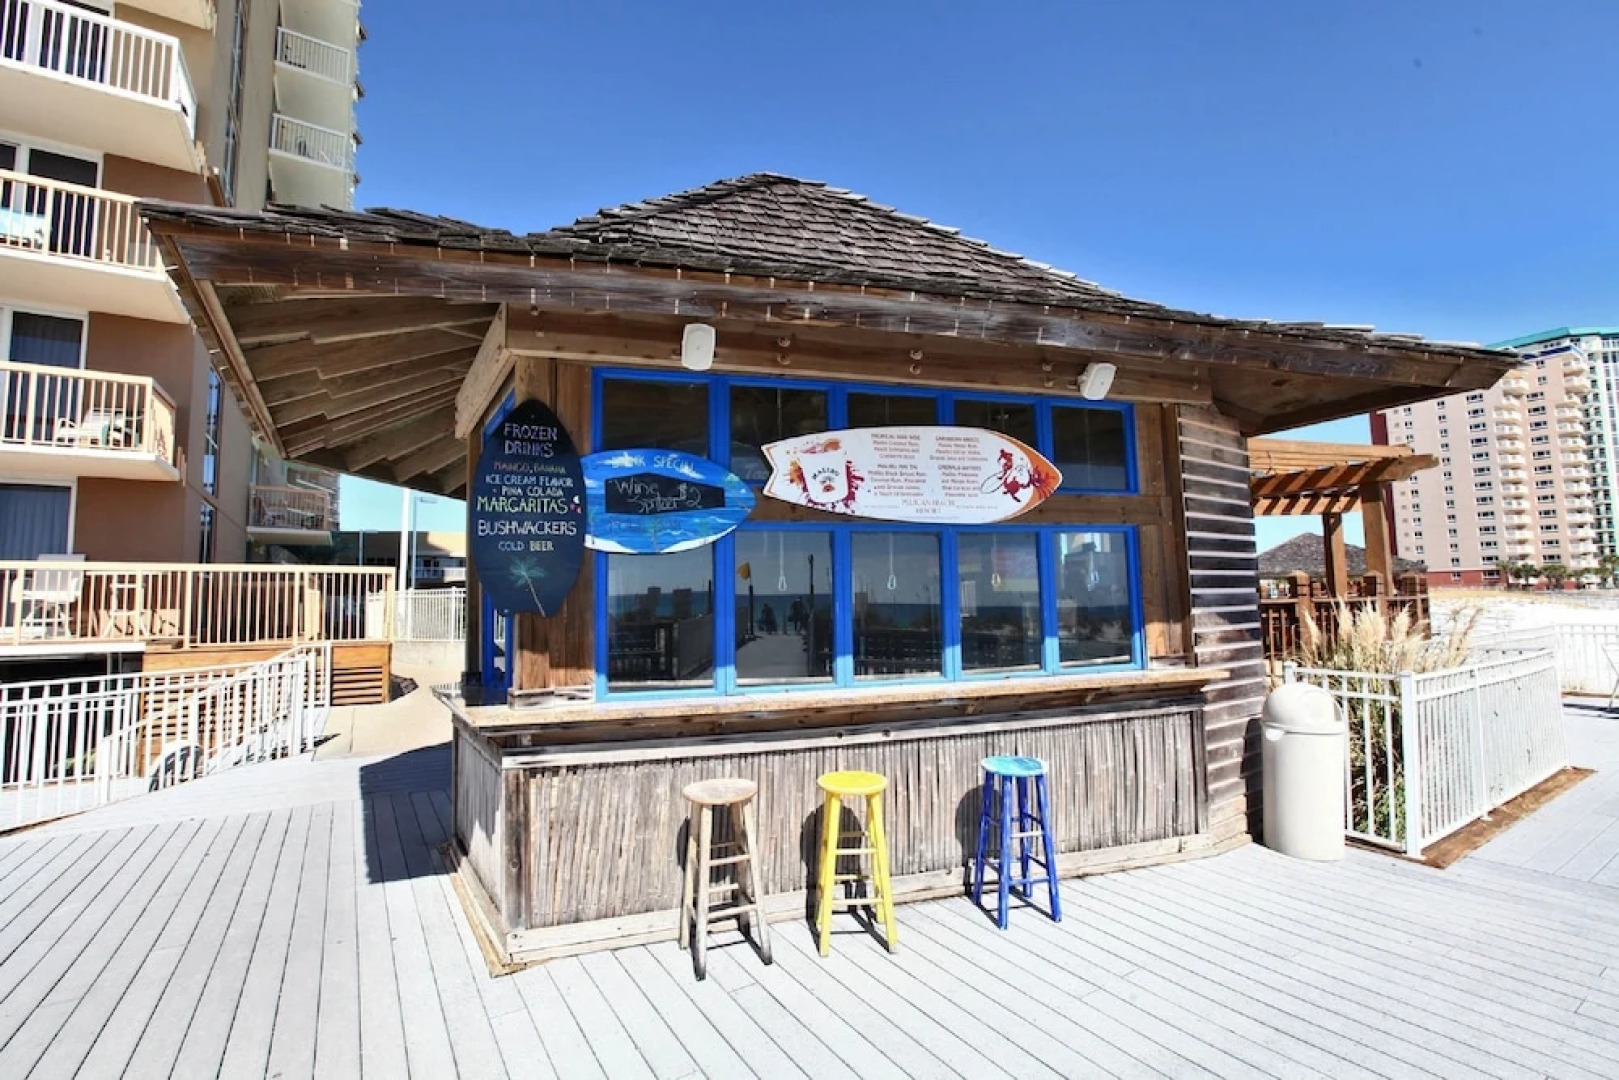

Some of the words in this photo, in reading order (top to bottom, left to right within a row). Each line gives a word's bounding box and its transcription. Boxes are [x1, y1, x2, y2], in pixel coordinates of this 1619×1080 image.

[504, 422, 558, 441] FROZEN
[504, 440, 554, 459] DRINKS
[485, 474, 501, 485] ICE
[503, 475, 537, 485] CREAM
[539, 476, 574, 488] FLAVOR
[614, 477, 659, 496] Wine
[526, 487, 564, 497] COLADA
[678, 483, 702, 508] $2
[476, 495, 568, 514] MARGARITAS
[477, 519, 577, 537] BUSHWACKERS
[498, 541, 525, 551] COLD
[529, 541, 555, 552] BEER
